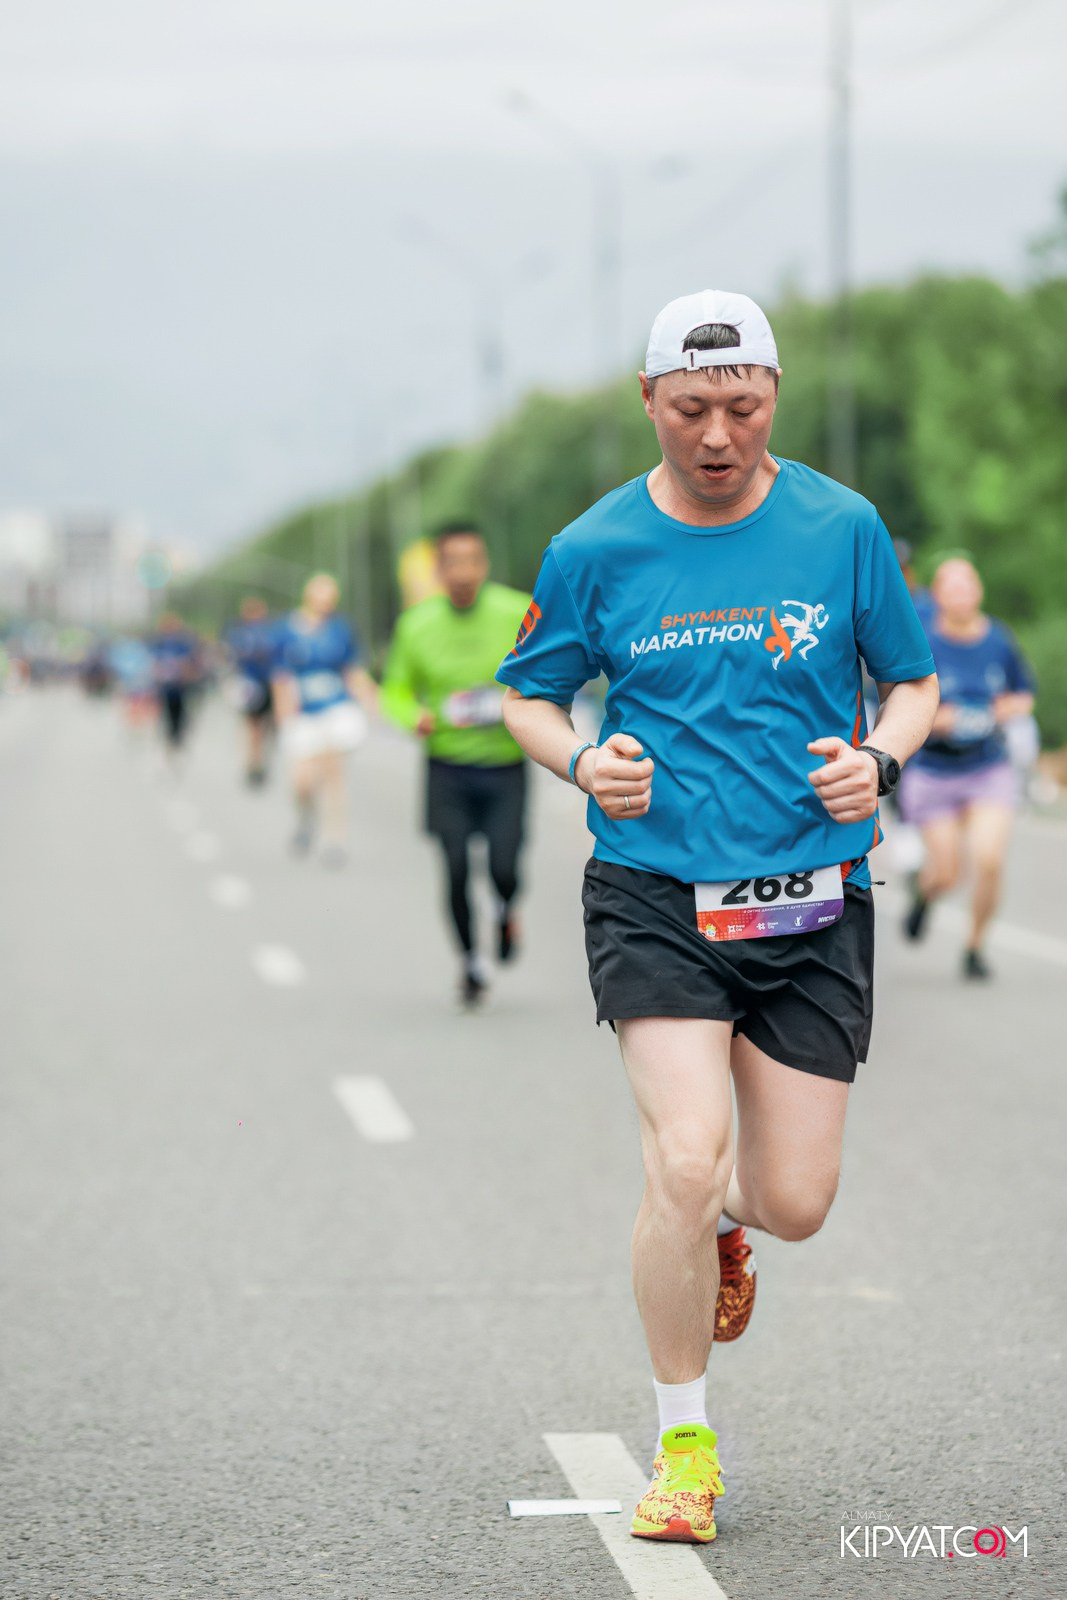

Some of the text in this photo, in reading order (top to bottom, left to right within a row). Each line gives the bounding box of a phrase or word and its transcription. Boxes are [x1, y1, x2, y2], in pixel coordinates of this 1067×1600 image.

[660, 607, 767, 629] SHYMKENT
[630, 623, 764, 659] MARATHON
[721, 871, 814, 905] 268
